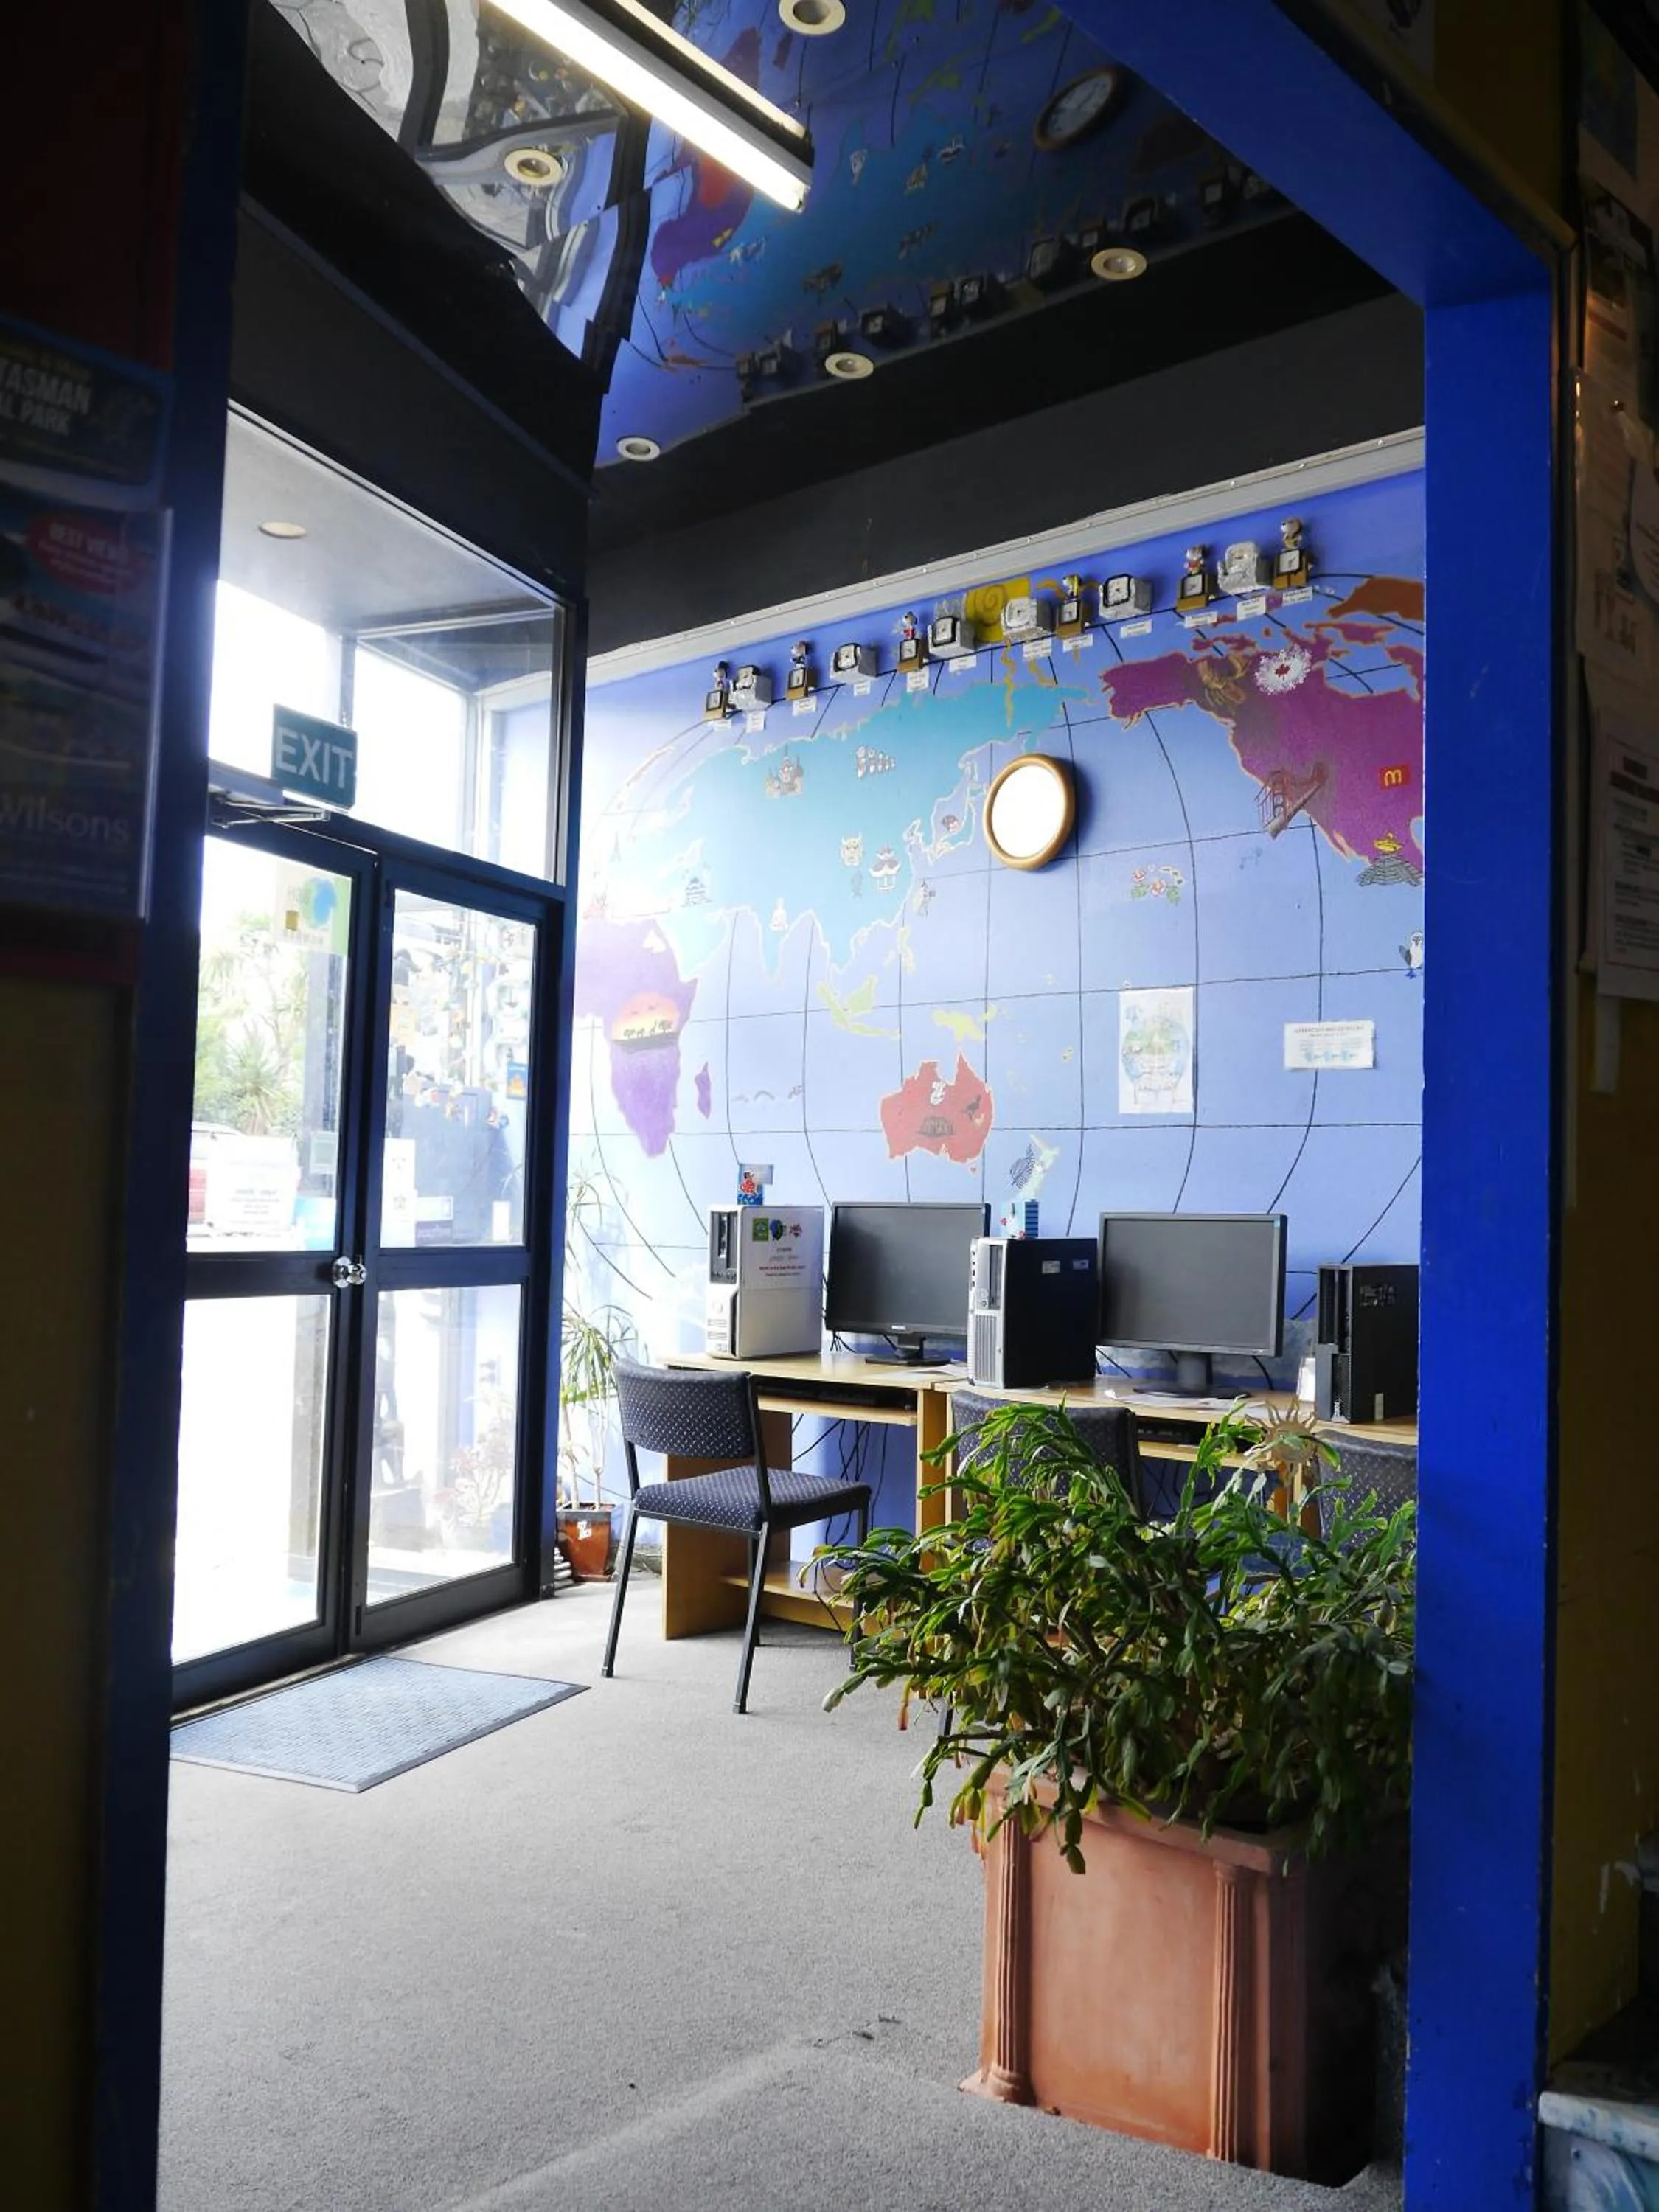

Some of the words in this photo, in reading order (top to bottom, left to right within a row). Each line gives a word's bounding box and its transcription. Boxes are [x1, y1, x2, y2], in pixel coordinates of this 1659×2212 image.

[20, 400, 71, 437] PARK
[275, 726, 354, 789] EXIT
[0, 793, 131, 846] Wilsons
